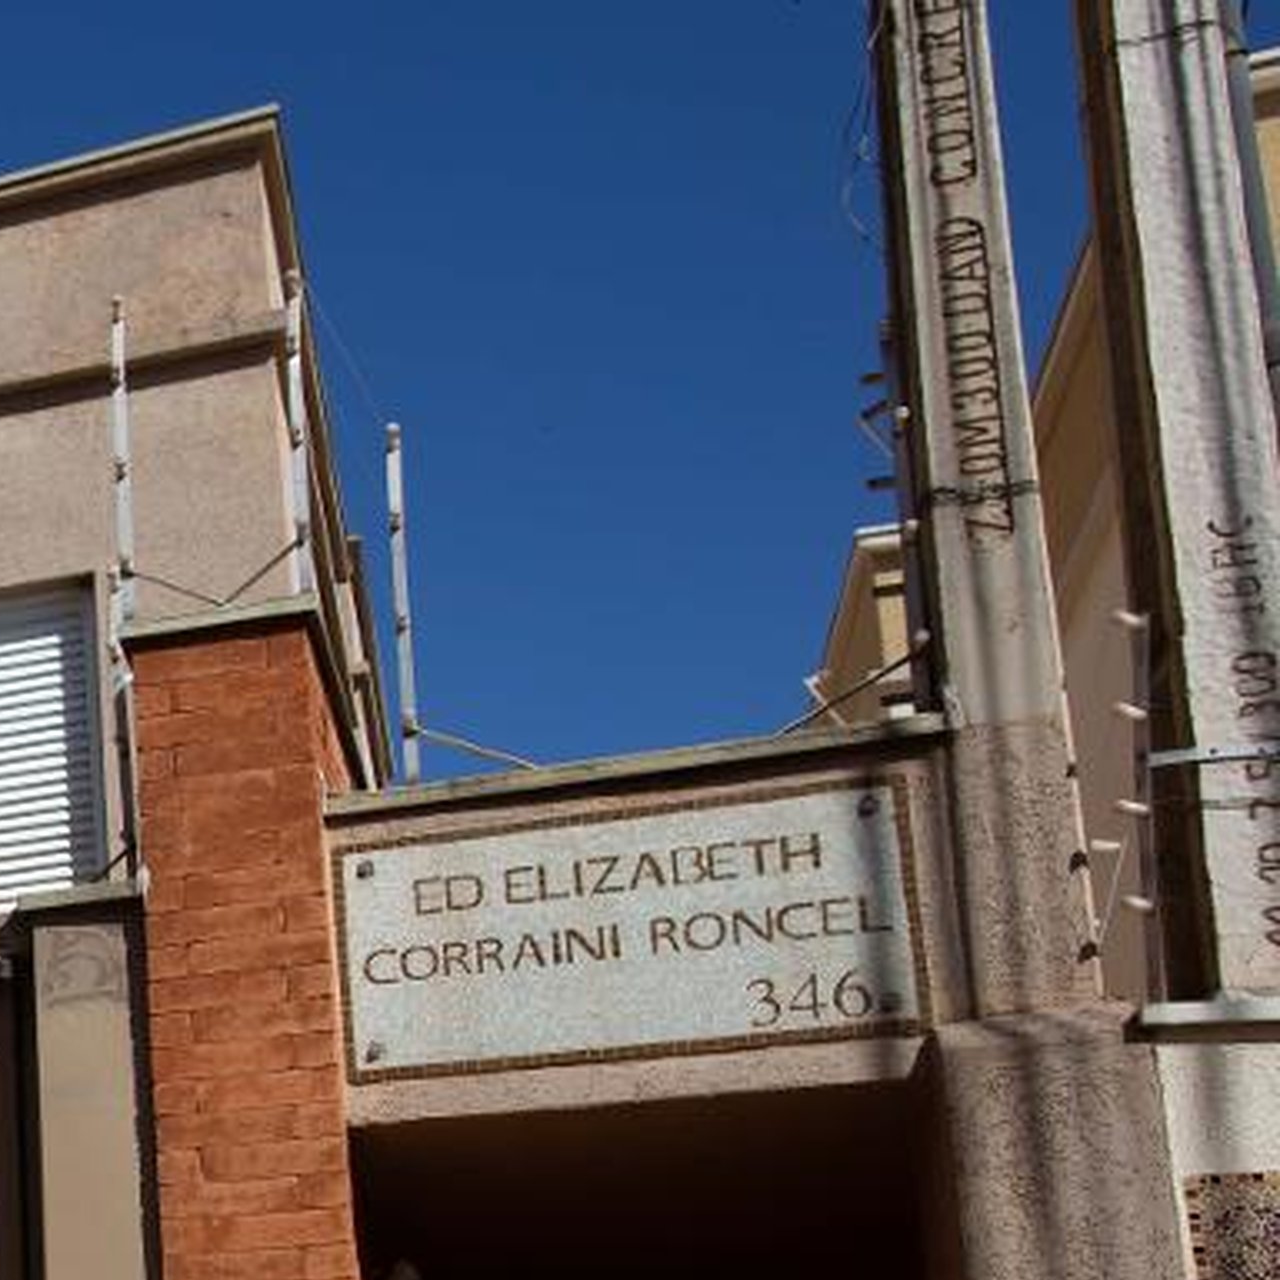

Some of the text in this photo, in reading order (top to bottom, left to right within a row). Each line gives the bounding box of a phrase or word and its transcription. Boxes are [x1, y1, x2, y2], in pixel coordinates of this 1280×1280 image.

[412, 831, 823, 916] ED ELIZABETH
[362, 895, 895, 985] CORRAINI RONCEL
[746, 968, 873, 1028] 346
